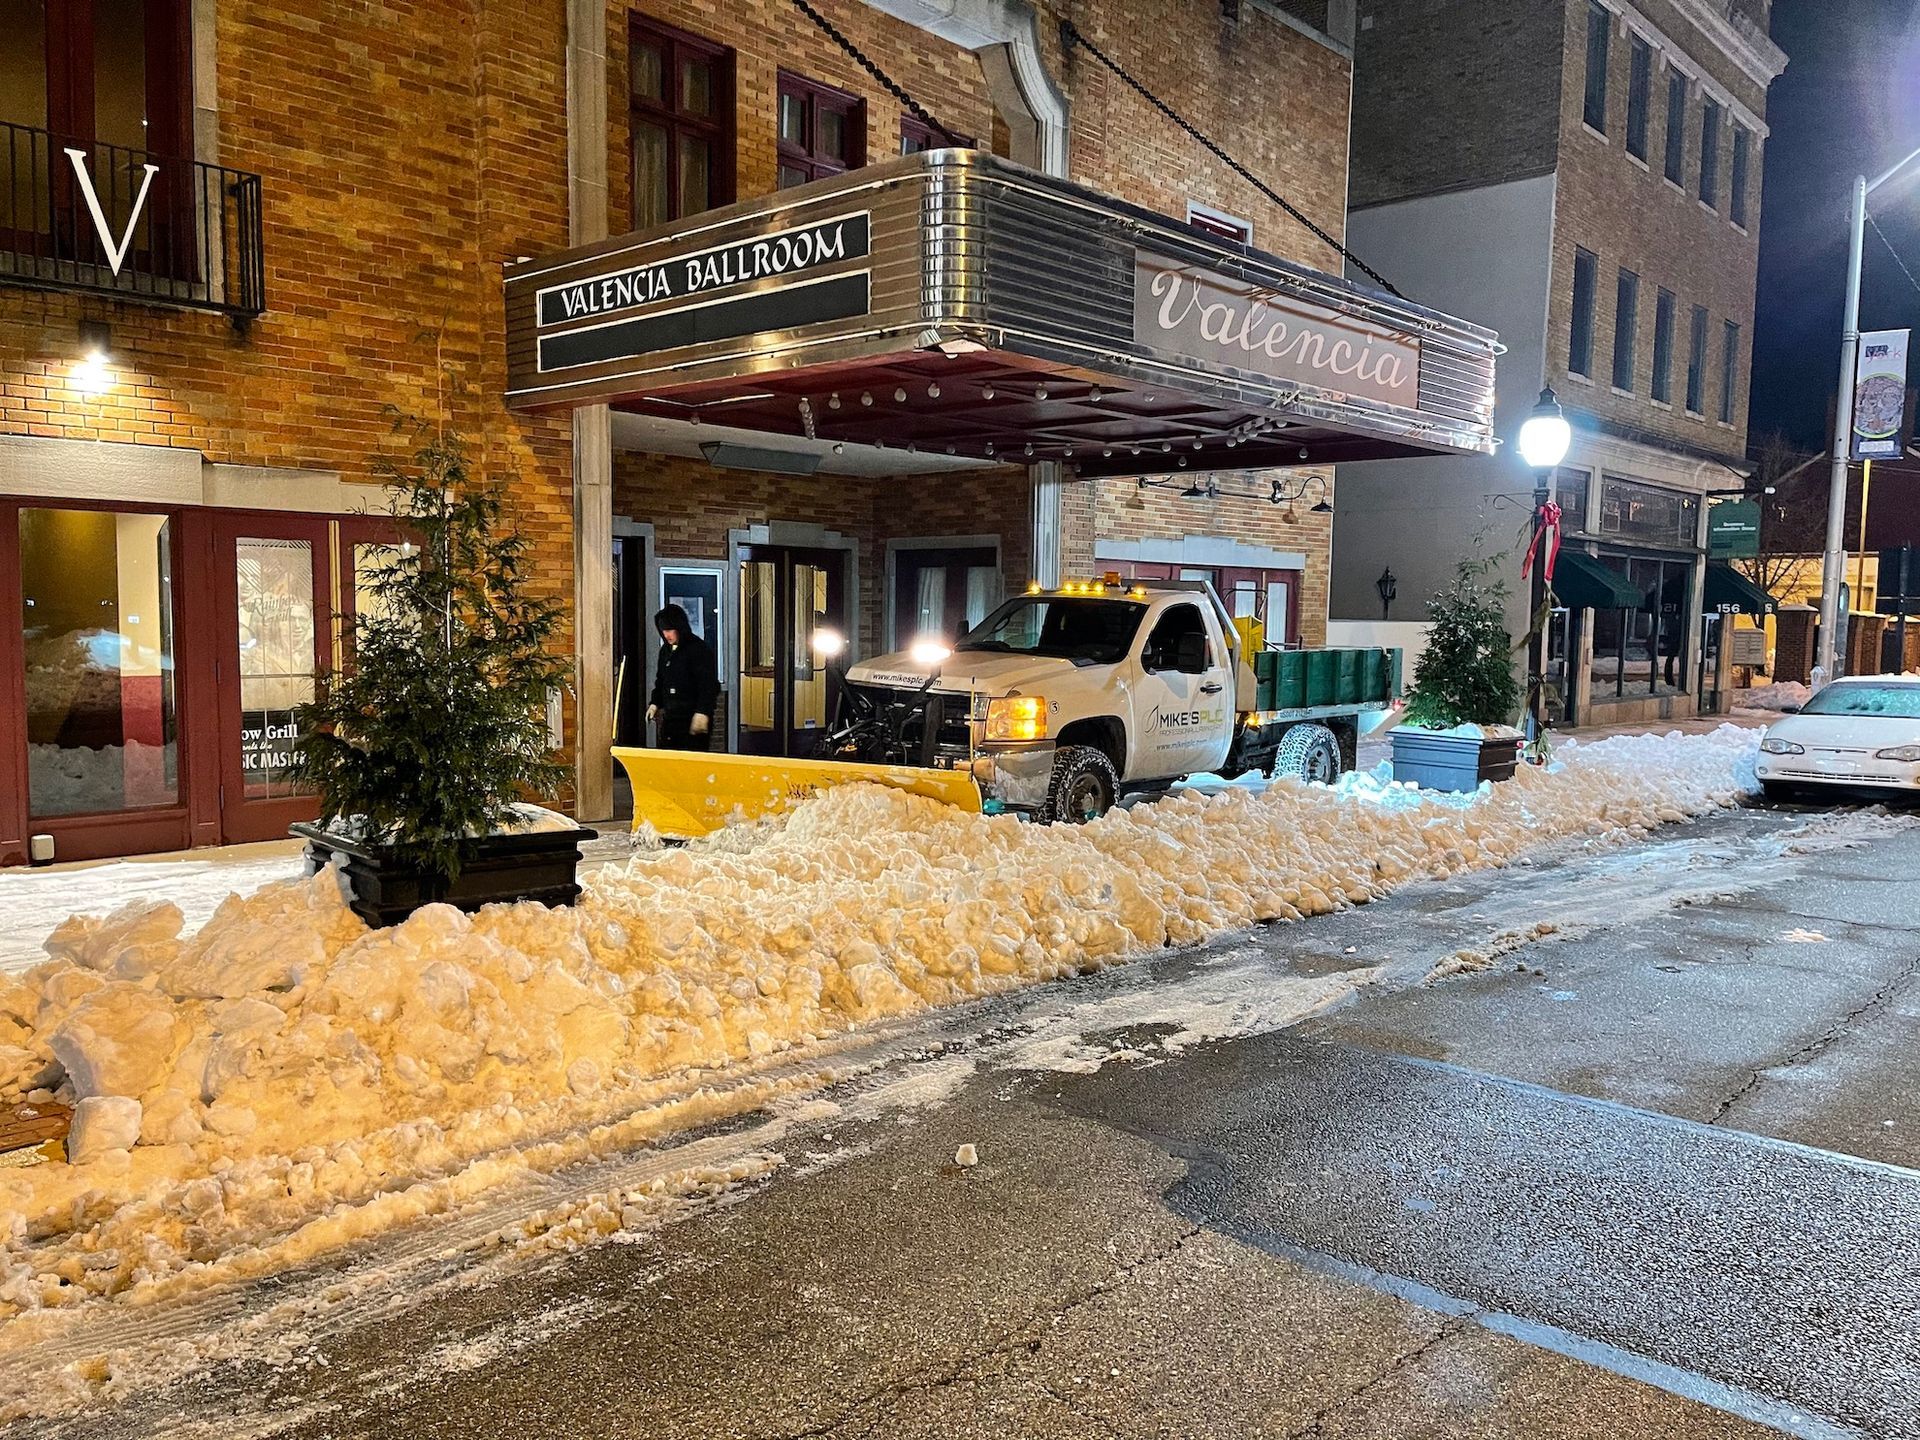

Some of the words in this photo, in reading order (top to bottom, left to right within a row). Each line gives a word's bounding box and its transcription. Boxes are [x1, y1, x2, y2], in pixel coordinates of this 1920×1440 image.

[64, 147, 160, 277] V
[560, 267, 671, 318] VALENCIA
[685, 222, 847, 292] BALLROOM
[1150, 270, 1408, 389] Valencia
[1716, 603, 1741, 613] 156
[872, 673, 943, 687] www.mikesplc.m
[266, 723, 299, 740] Grill
